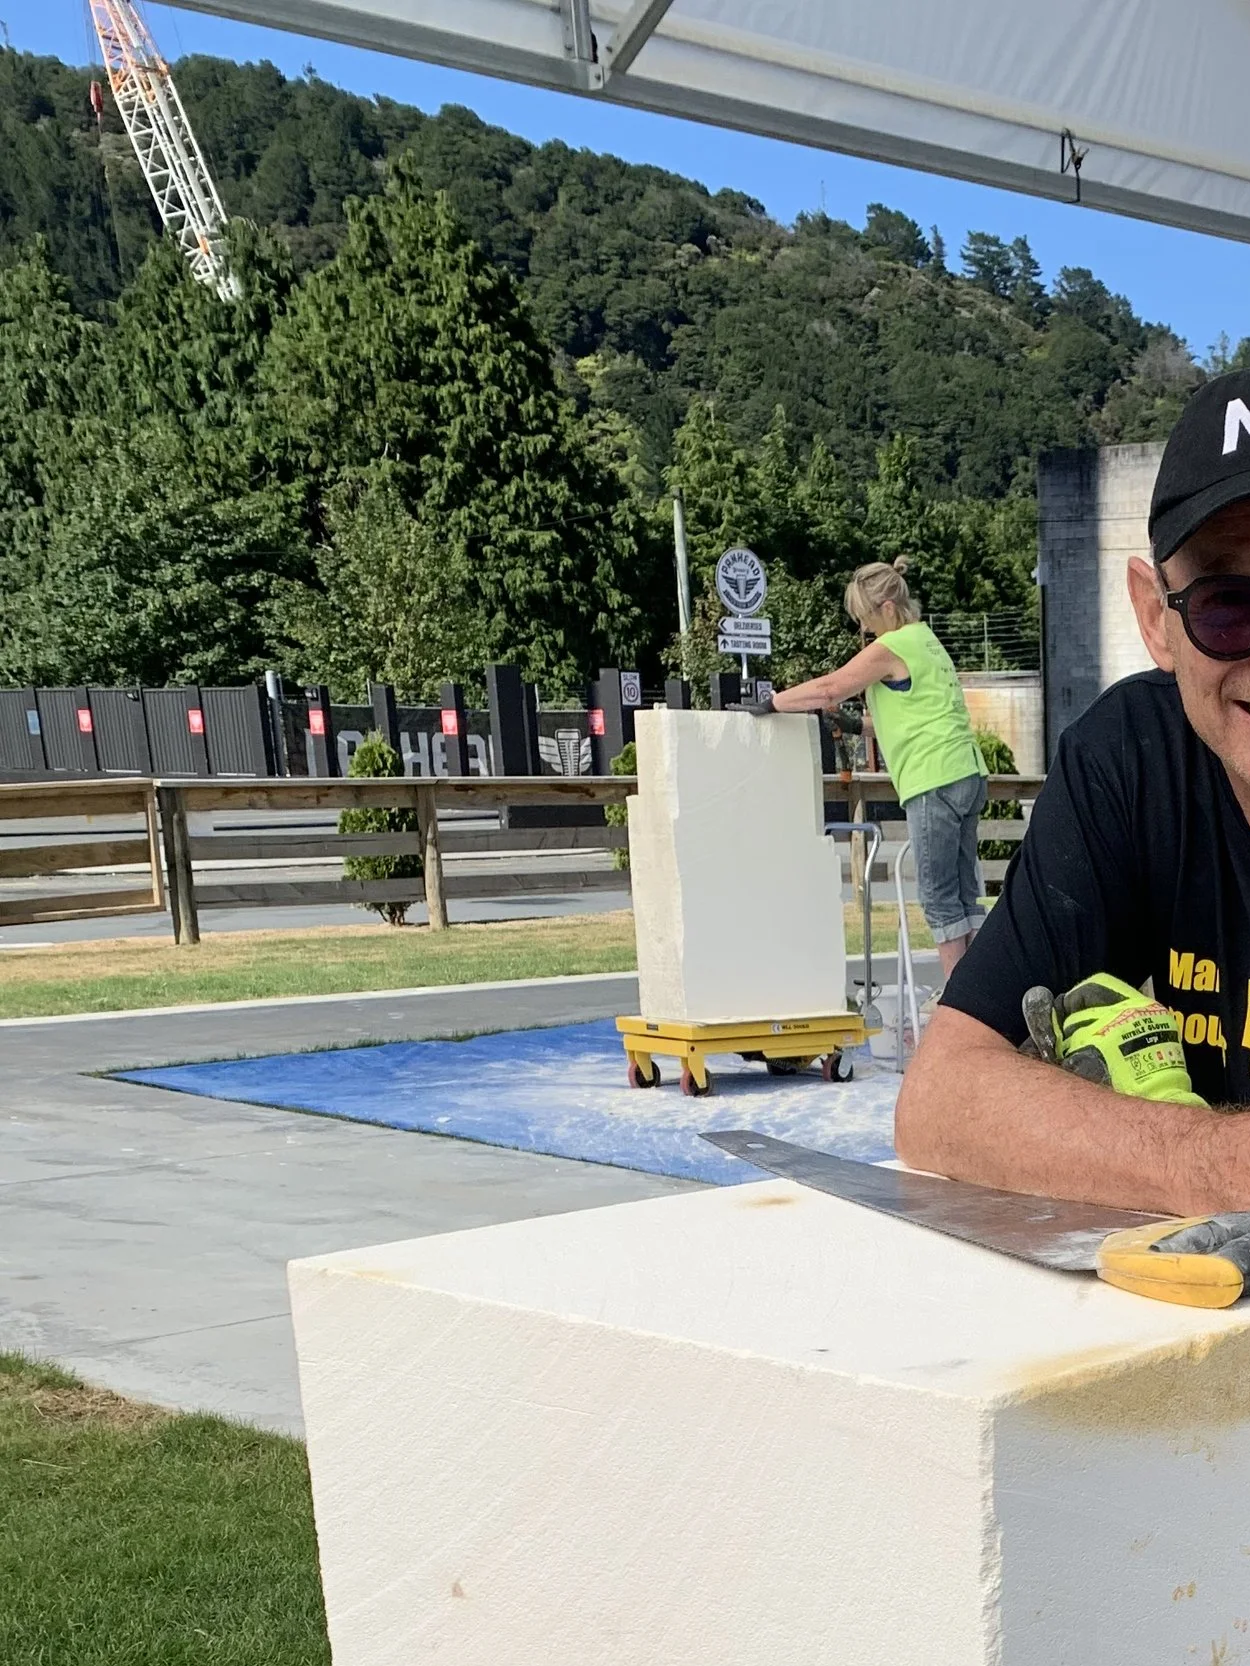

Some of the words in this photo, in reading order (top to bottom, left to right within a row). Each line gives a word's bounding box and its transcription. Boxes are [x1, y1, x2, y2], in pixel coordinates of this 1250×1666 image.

[721, 552, 760, 576] PANHEAD
[626, 686, 636, 698] 10
[1132, 1020, 1142, 1029] HI
[1121, 1026, 1146, 1040] NITRILE
